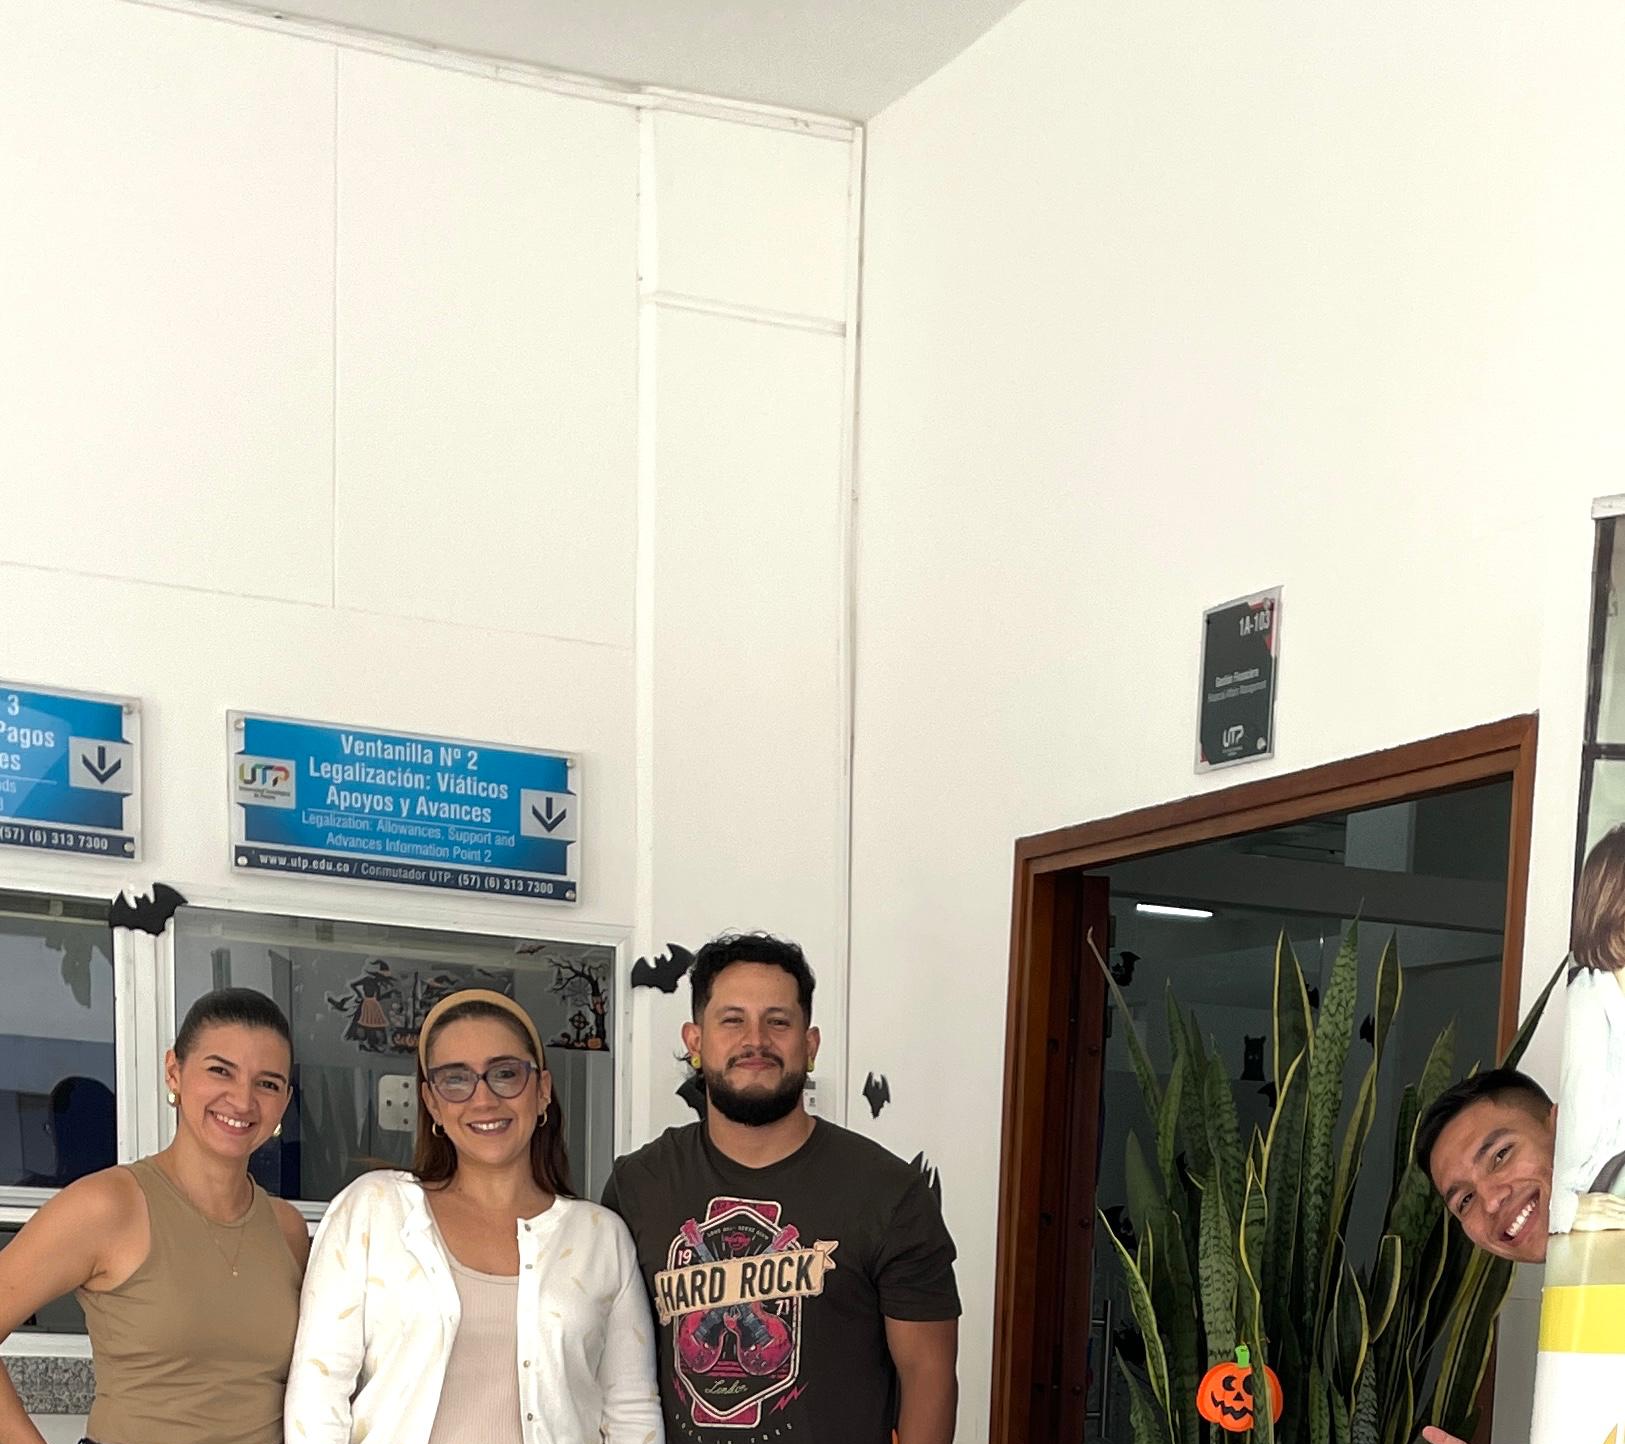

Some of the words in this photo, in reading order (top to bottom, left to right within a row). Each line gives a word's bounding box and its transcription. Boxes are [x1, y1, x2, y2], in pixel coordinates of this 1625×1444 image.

[1239, 610, 1270, 636] 1A-103
[7, 694, 20, 716] 3
[341, 734, 433, 765] Ventanilla
[467, 750, 479, 770] 2
[239, 763, 290, 787] UTP
[309, 756, 431, 790] Legalización:
[437, 772, 509, 800] Viáticos
[326, 785, 394, 813] Apoyos
[400, 796, 411, 817] y
[416, 796, 492, 823] Avances
[52, 833, 74, 847] 313
[77, 836, 108, 850] 7300
[326, 831, 383, 850] Advances
[386, 838, 450, 858] Information
[453, 845, 481, 861] Point
[484, 849, 492, 862] 2
[448, 826, 492, 846] Support
[494, 833, 516, 848] and
[259, 853, 350, 874] www.utp.edu.co
[361, 862, 426, 881] Conmutador
[458, 873, 480, 888] (57)
[484, 876, 500, 890] (6)
[503, 878, 523, 892] 313
[527, 881, 553, 894] 7300
[678, 1249, 692, 1266] 19
[660, 1265, 727, 1311] HARD
[739, 1254, 817, 1299] ROCK
